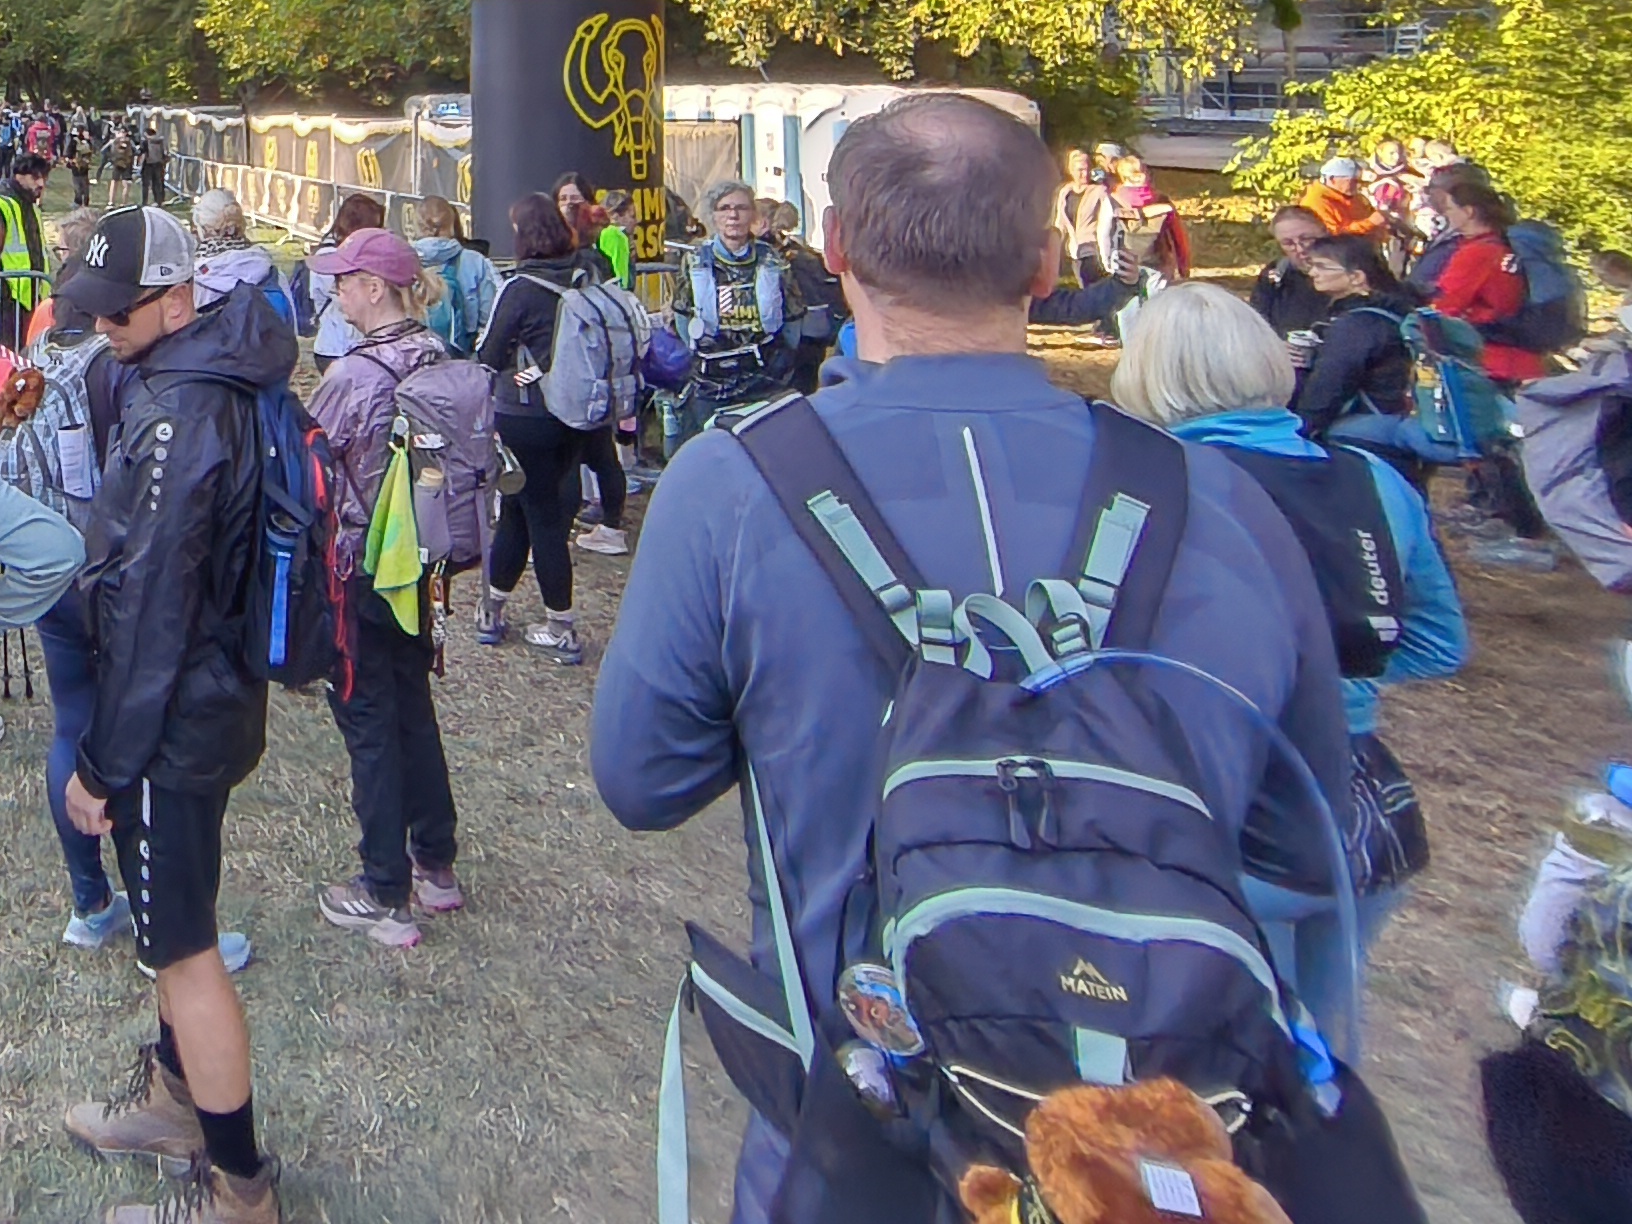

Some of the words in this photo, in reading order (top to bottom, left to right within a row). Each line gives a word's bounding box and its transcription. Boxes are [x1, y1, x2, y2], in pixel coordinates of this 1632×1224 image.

[85, 233, 110, 267] NY
[1357, 529, 1389, 605] deuter
[1060, 975, 1128, 1001] MATEIN
